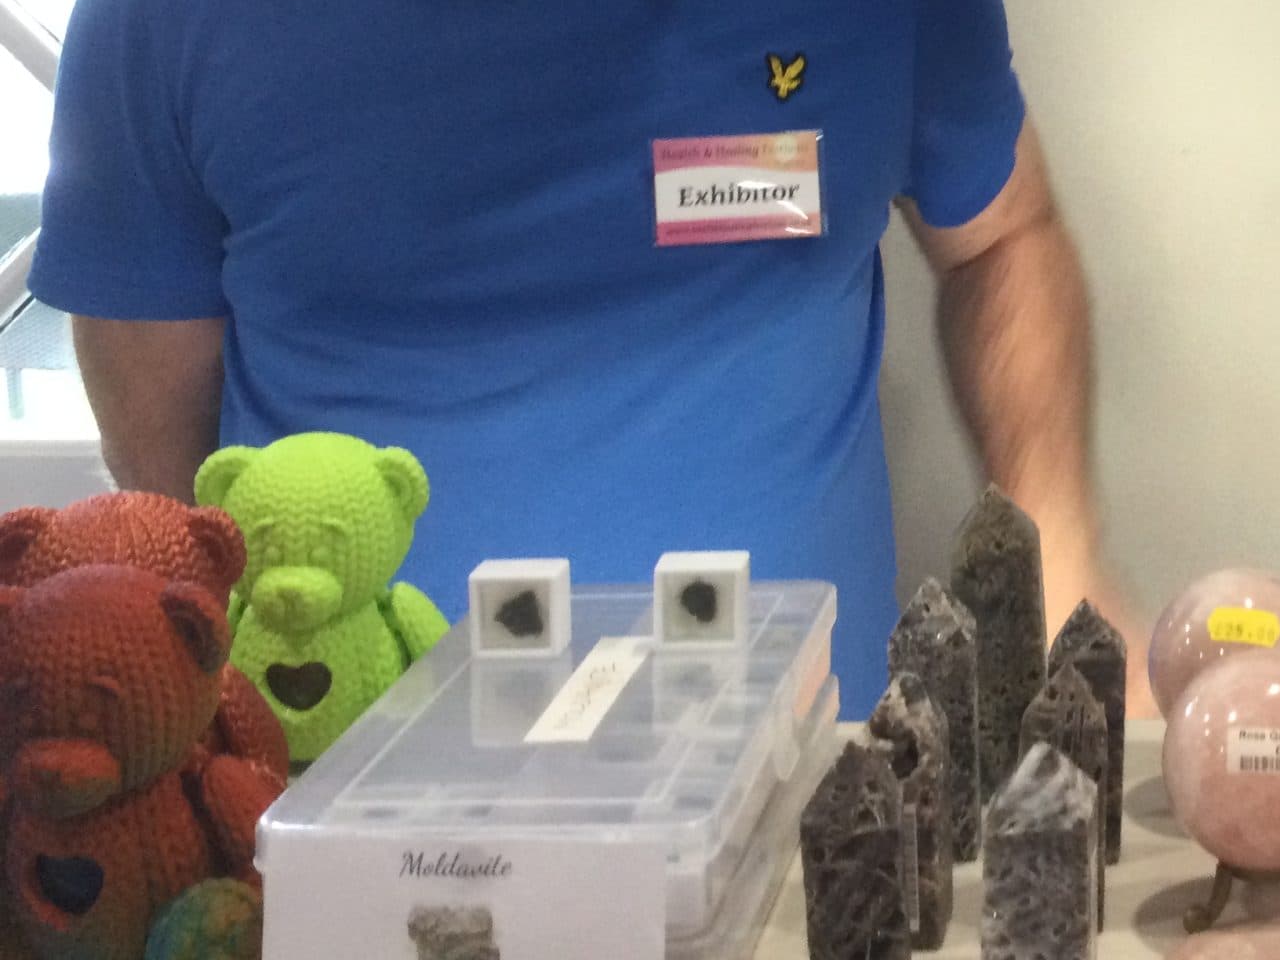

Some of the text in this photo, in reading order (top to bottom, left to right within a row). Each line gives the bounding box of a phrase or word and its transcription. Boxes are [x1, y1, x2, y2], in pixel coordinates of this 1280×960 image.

[678, 183, 800, 208] Exhibitor
[1239, 729, 1266, 740] Rose
[399, 850, 513, 879] Moldavite
